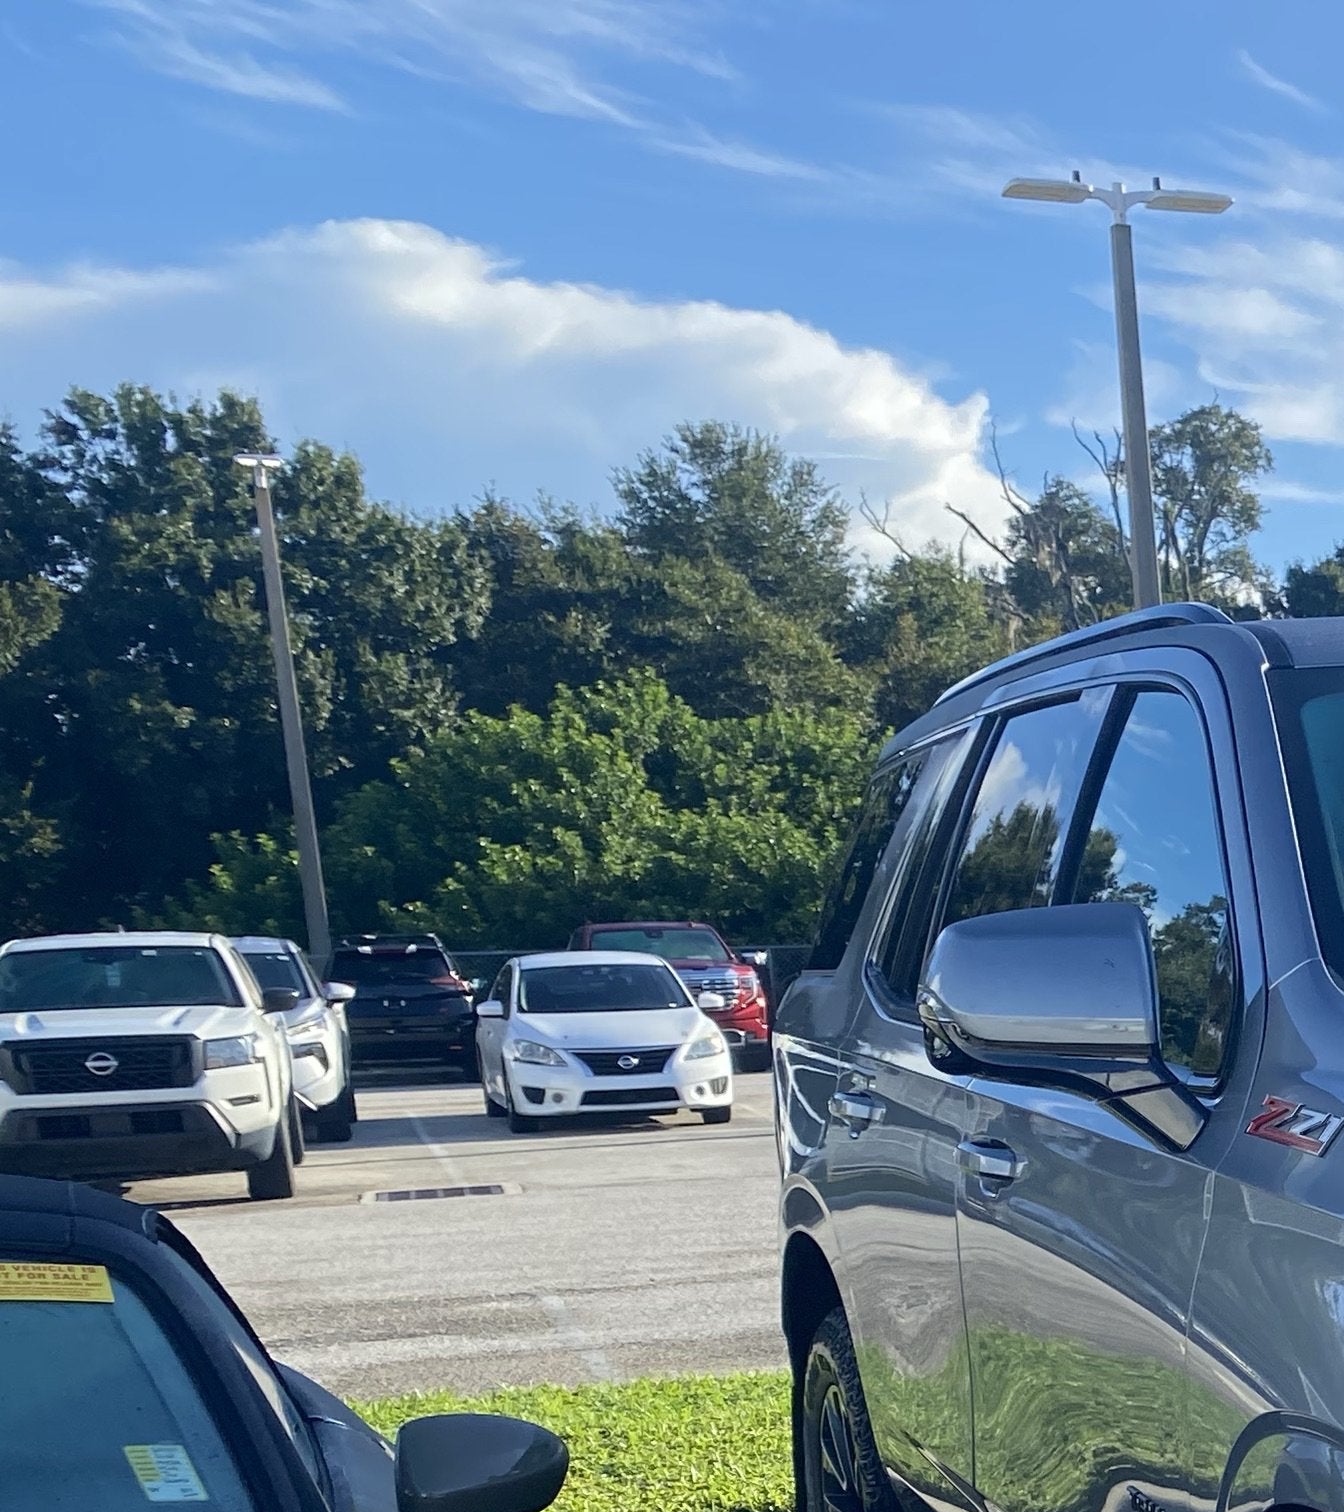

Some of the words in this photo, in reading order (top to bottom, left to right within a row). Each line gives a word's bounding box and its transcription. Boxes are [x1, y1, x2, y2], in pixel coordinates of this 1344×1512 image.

[12, 1265, 75, 1273] VEHICLE
[17, 1272, 46, 1280] FOR
[52, 1273, 90, 1281] SALE
